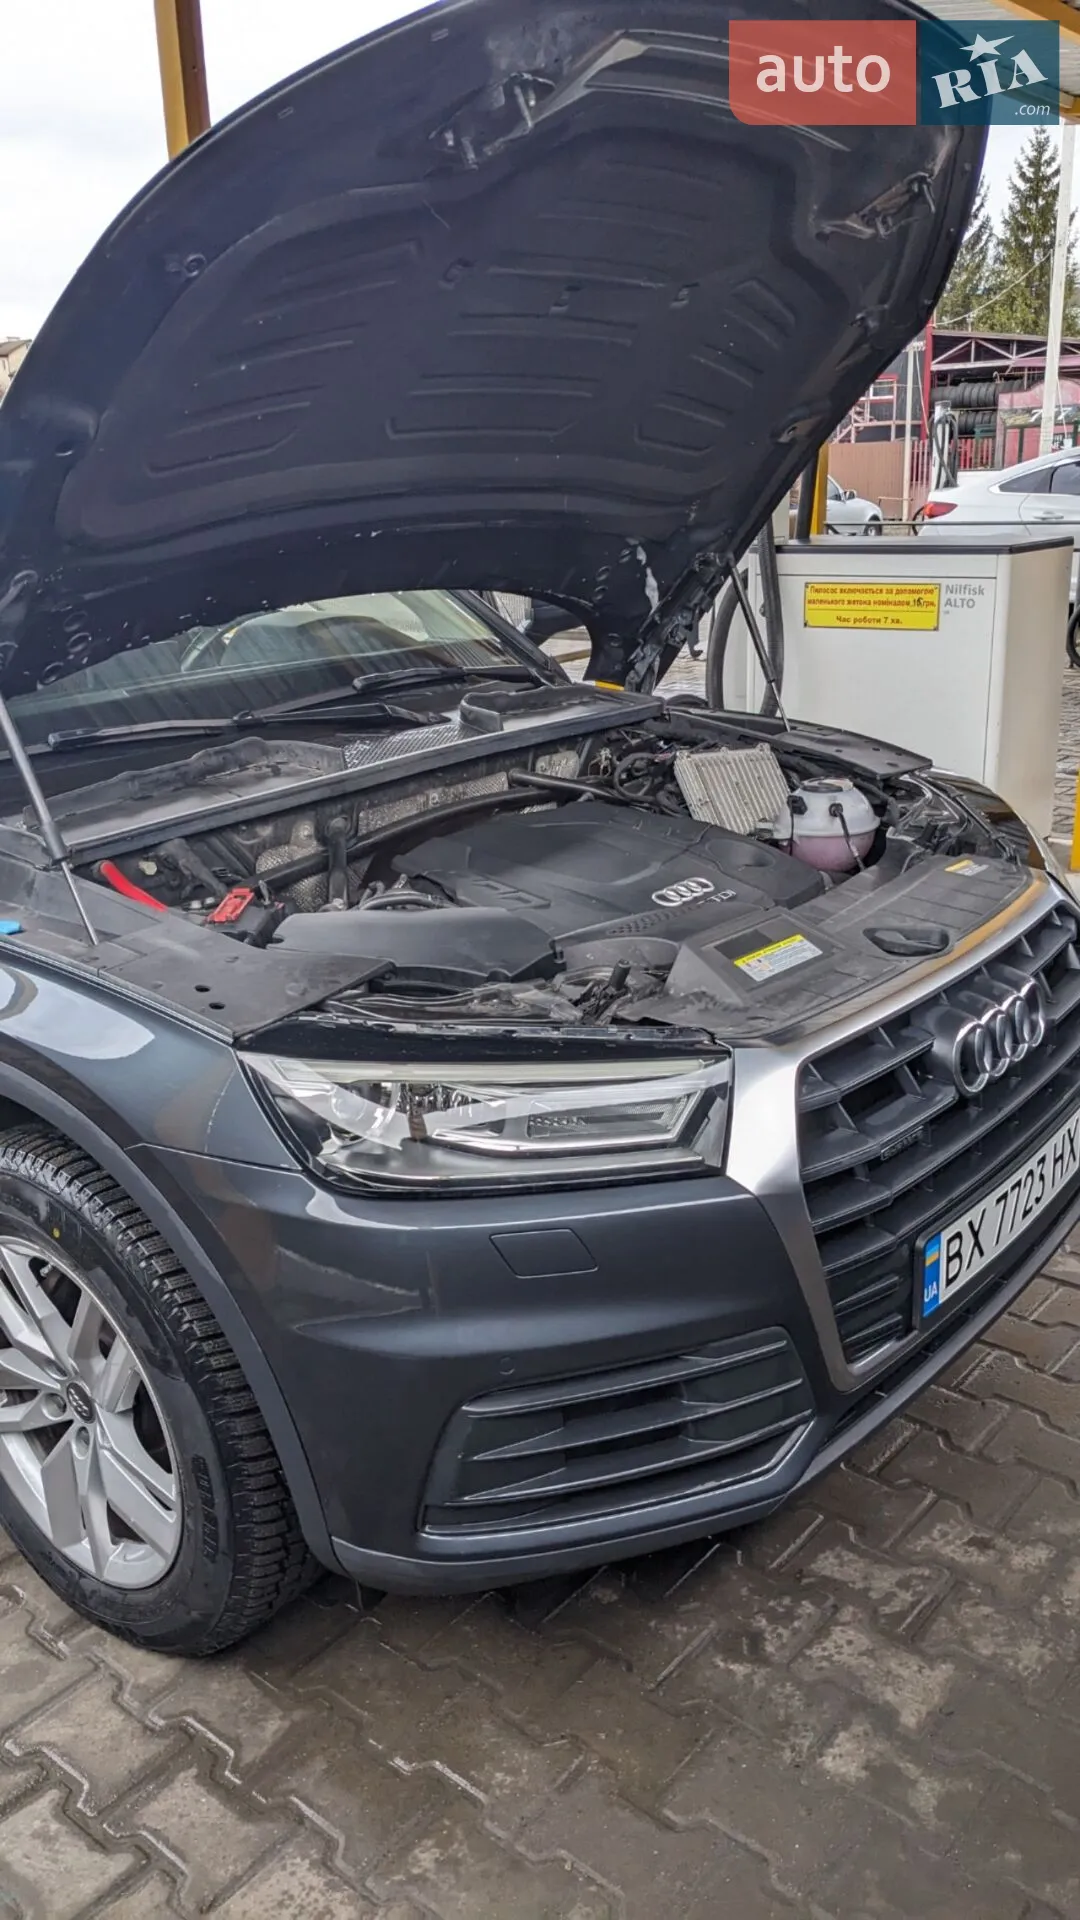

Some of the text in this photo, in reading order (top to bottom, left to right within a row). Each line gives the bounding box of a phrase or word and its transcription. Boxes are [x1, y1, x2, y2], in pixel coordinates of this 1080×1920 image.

[945, 584, 985, 596] Nilfisk
[944, 598, 976, 609] ALTO
[836, 615, 851, 623] Час
[853, 616, 881, 625] роботи
[883, 616, 889, 625] 7
[945, 1115, 1079, 1288] BX 7723 HX
[924, 1283, 938, 1303] UA
